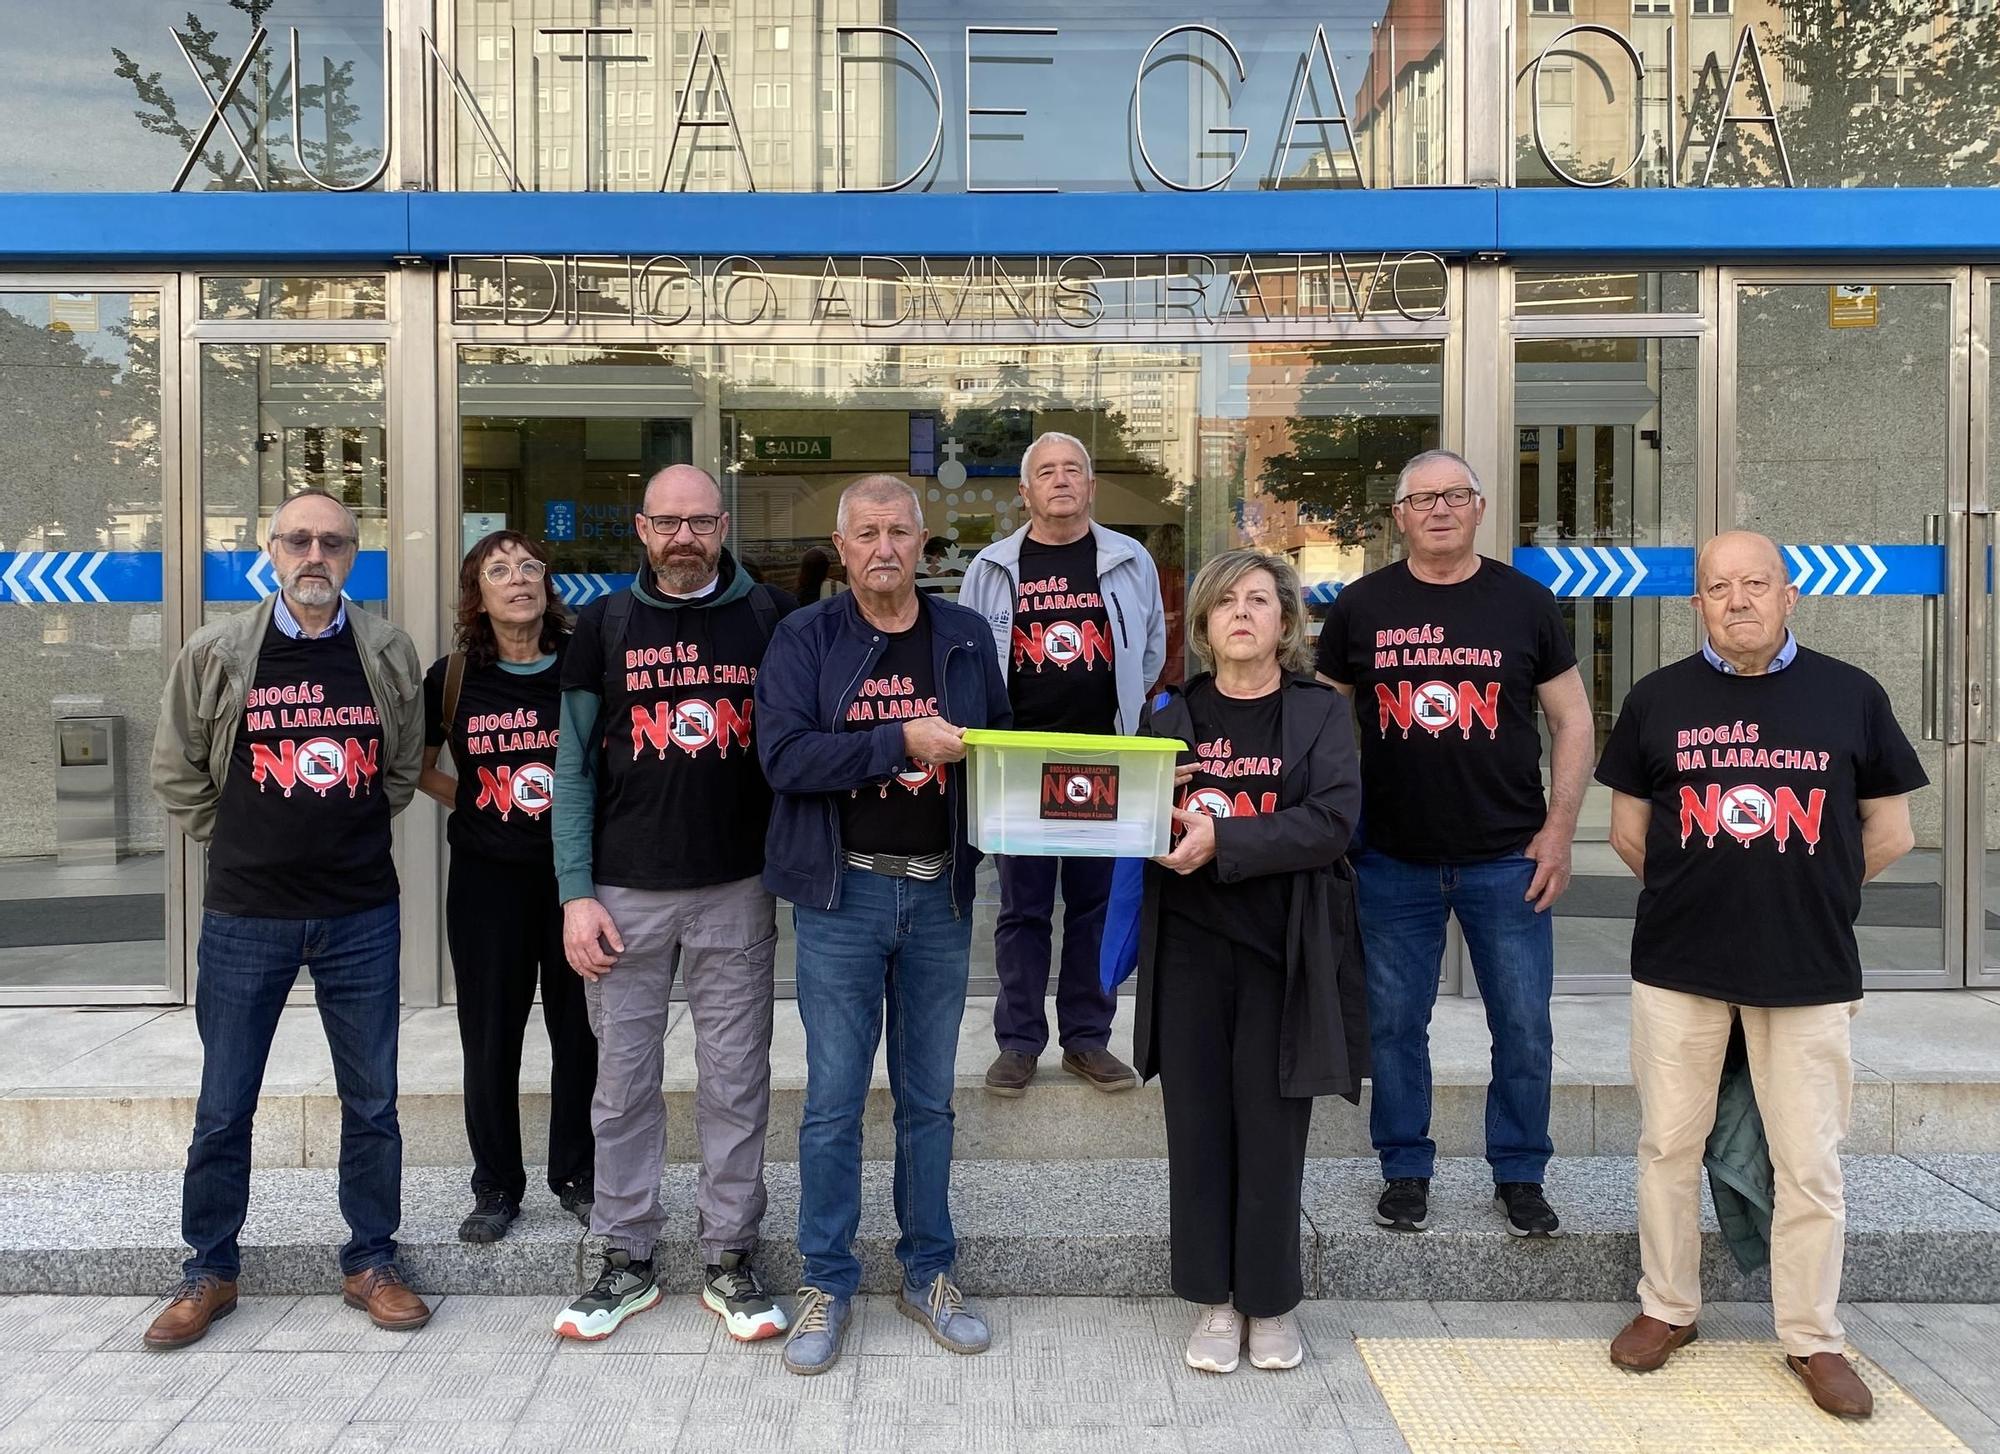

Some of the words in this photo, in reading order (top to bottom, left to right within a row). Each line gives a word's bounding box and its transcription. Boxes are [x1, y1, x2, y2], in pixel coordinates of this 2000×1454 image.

[169, 25, 757, 193] XUNTA
[836, 25, 1059, 193] DE
[1136, 23, 1794, 190] GALICIA
[448, 254, 769, 327] EDIFICIO
[809, 251, 1449, 328] ADMINISTRATIVO
[764, 440, 822, 455] SAIDA
[1019, 575, 1068, 597] IOGÁS
[1376, 623, 1445, 648] BIOGÁS
[626, 641, 699, 669] BIOGÁS
[1375, 649, 1399, 669] NA
[1403, 647, 1502, 668] LARACHA?
[626, 670, 653, 691] NA
[247, 681, 325, 708] BIOGÁS
[247, 710, 276, 731] NA
[467, 708, 538, 733] BIOGÁS
[846, 701, 875, 721] NA
[877, 696, 939, 719] LARAC
[1375, 680, 1501, 740] NON
[468, 735, 495, 754] NA
[498, 729, 560, 752] LARAC
[631, 698, 753, 761] NON
[1678, 720, 1760, 748] BIOGÁS
[1197, 737, 1232, 758] GÁS
[1676, 750, 1706, 771] NA
[1712, 748, 1830, 771] LARACHA?
[250, 736, 380, 798] NON
[1200, 757, 1282, 778] ARACHA?
[476, 762, 555, 822] NO
[1042, 773, 1117, 809] NON
[1679, 783, 1827, 855] NON
